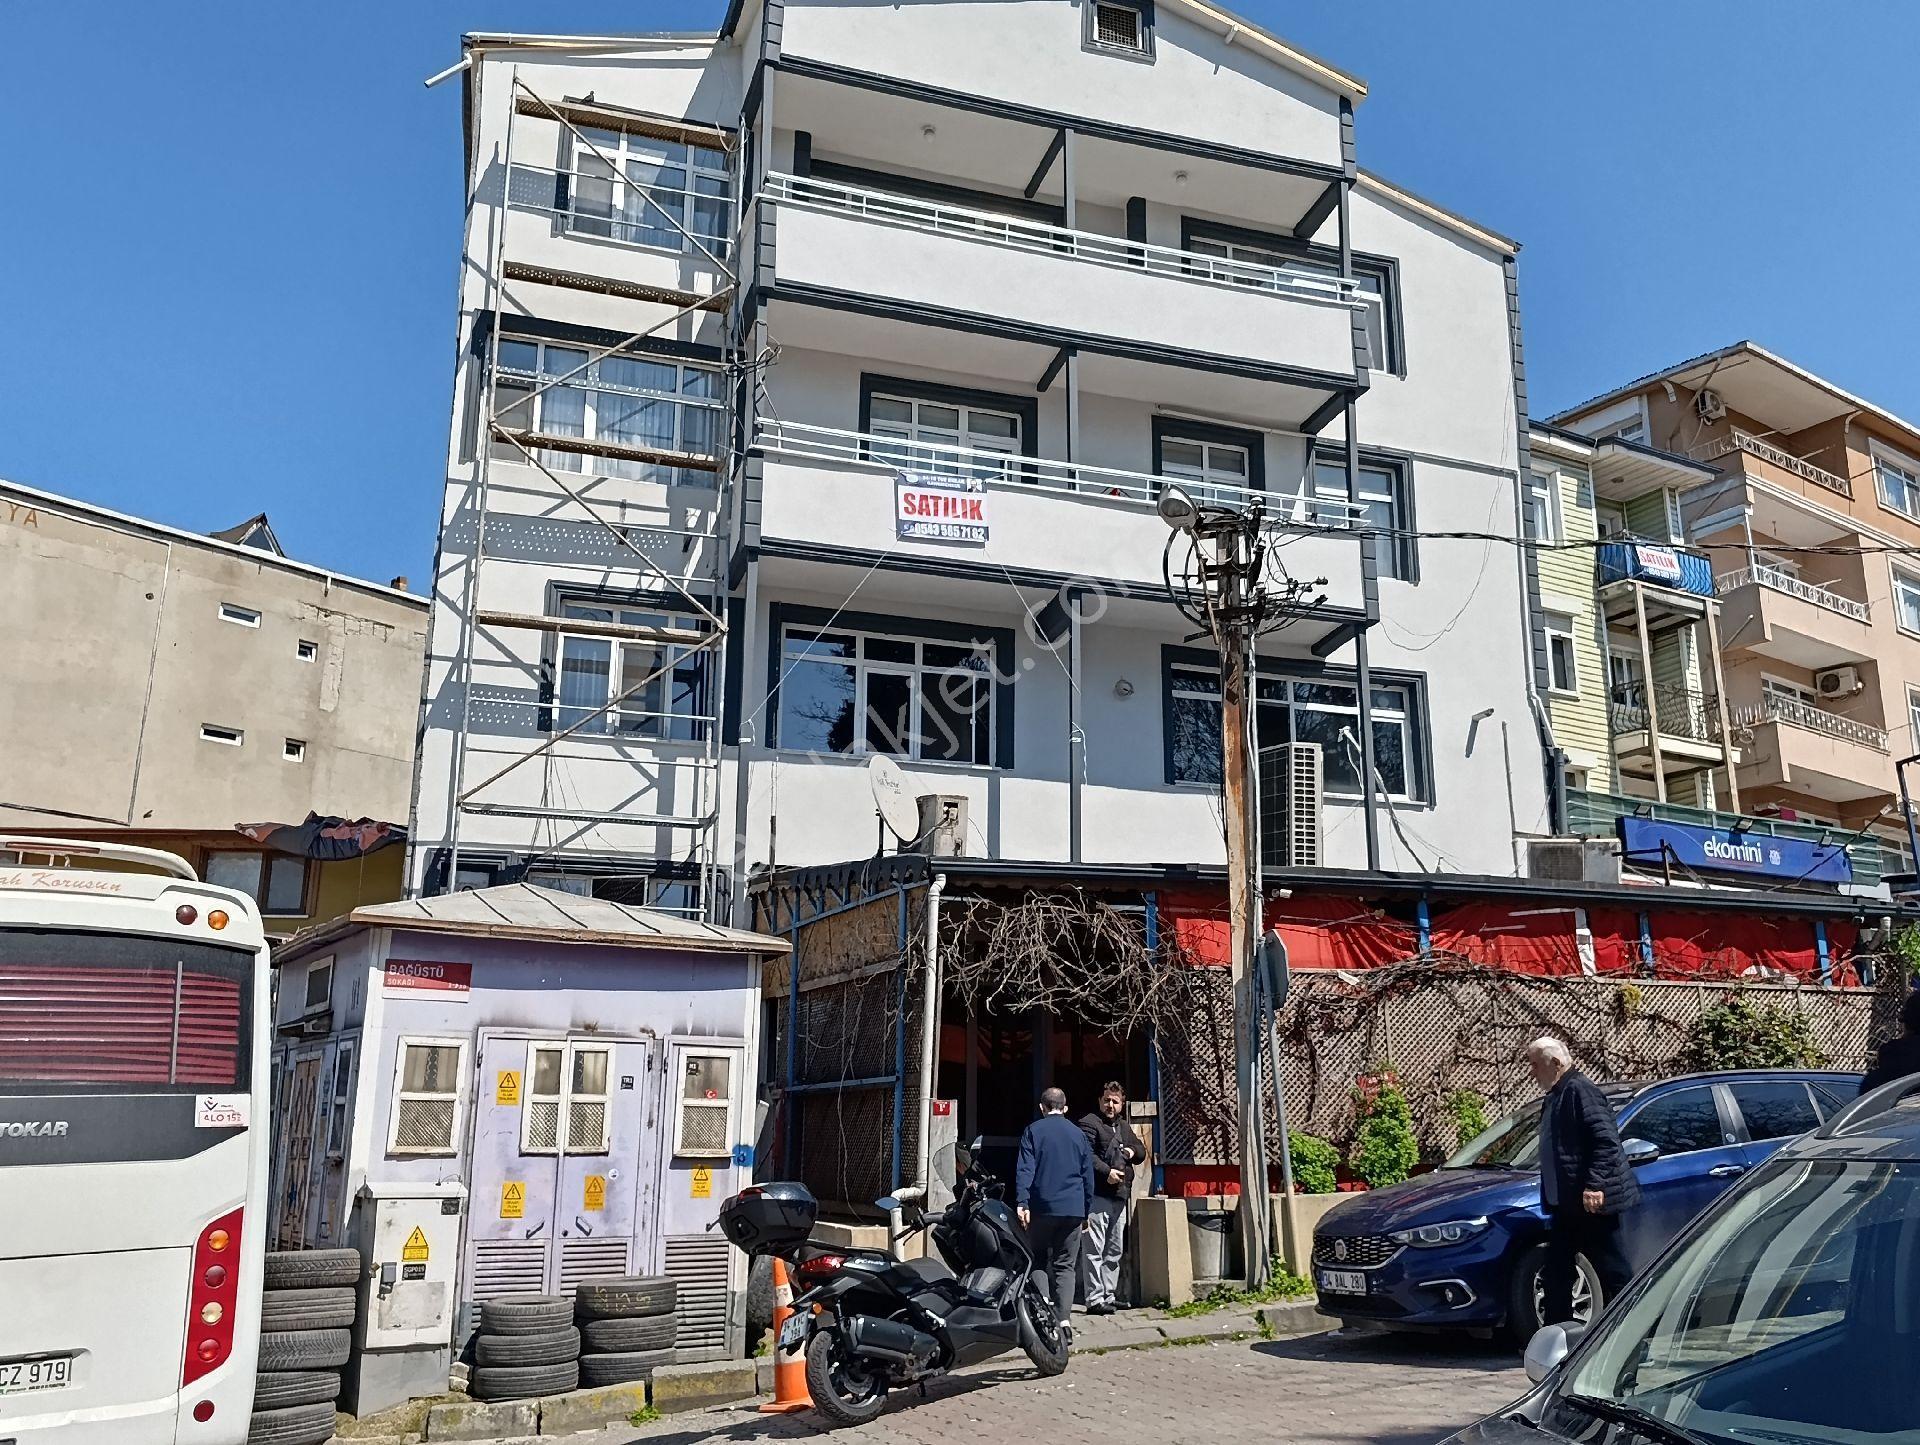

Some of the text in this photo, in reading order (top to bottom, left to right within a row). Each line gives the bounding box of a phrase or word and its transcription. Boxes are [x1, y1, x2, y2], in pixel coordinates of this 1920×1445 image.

[0, 503, 39, 529] YA
[903, 492, 984, 521] SATILIK
[961, 526, 971, 539] 71
[1640, 550, 1676, 570] SATILIK
[1703, 835, 1762, 863] ekomini
[31, 871, 121, 892] Korusun
[389, 963, 444, 978] BAĞÜSTÜ
[29, 1361, 66, 1383] 979
